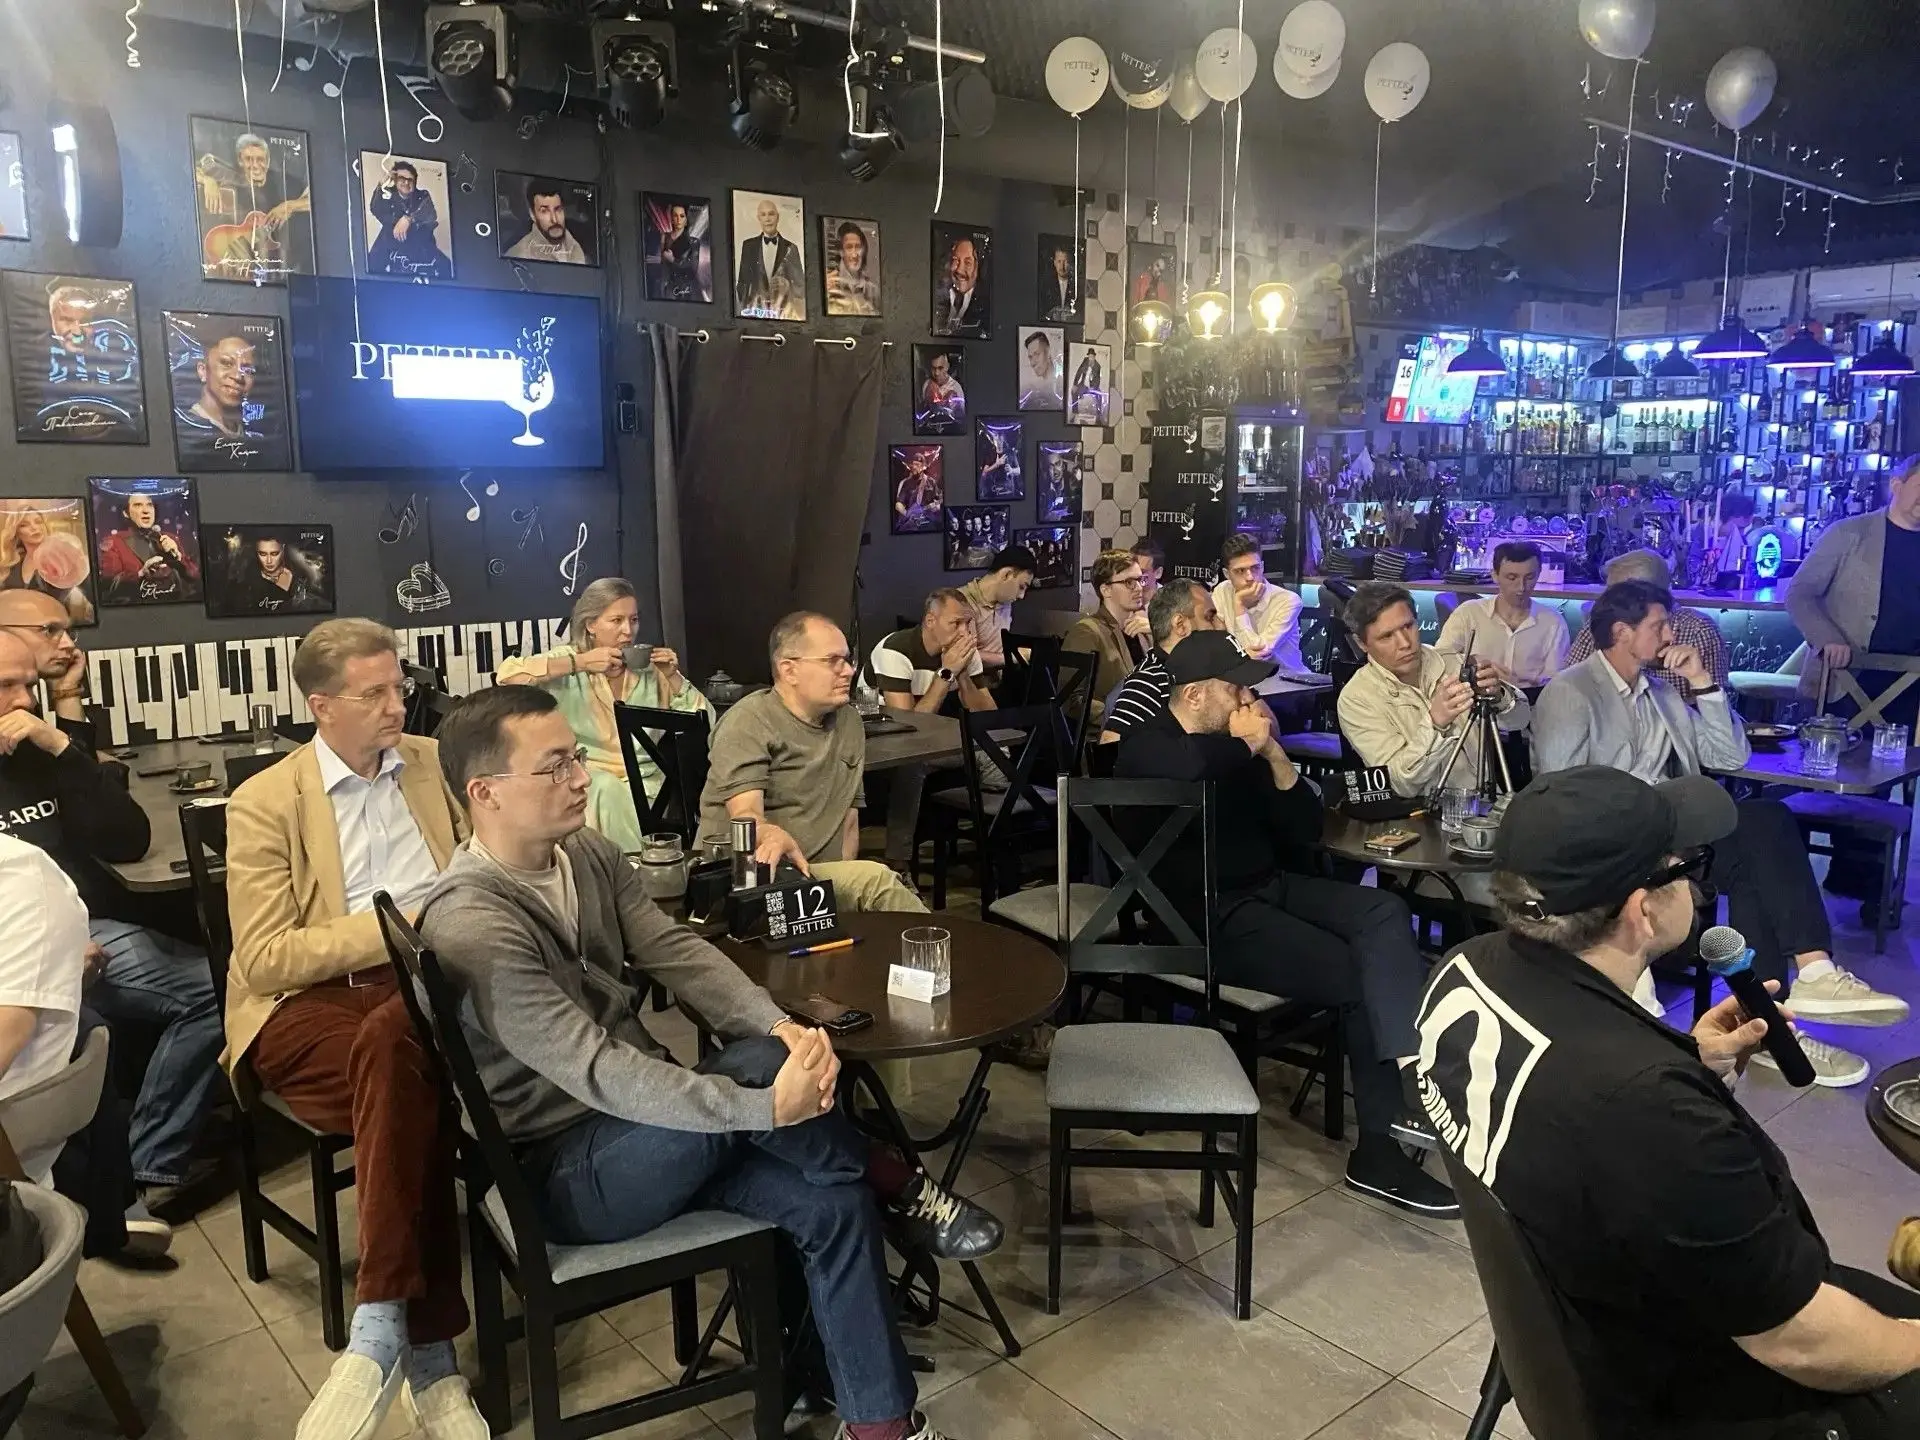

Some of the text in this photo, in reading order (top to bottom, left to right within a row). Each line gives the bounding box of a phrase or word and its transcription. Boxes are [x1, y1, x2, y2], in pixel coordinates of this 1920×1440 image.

[1400, 365, 1413, 378] 16
[1153, 425, 1191, 437] PETTER
[1177, 472, 1217, 485] PETTER
[1151, 510, 1188, 523] PETTER
[1174, 565, 1213, 579] PETTER
[1363, 768, 1386, 792] 10
[1363, 792, 1391, 802] PETTER
[793, 885, 829, 920] 12
[792, 918, 835, 936] PETTER
